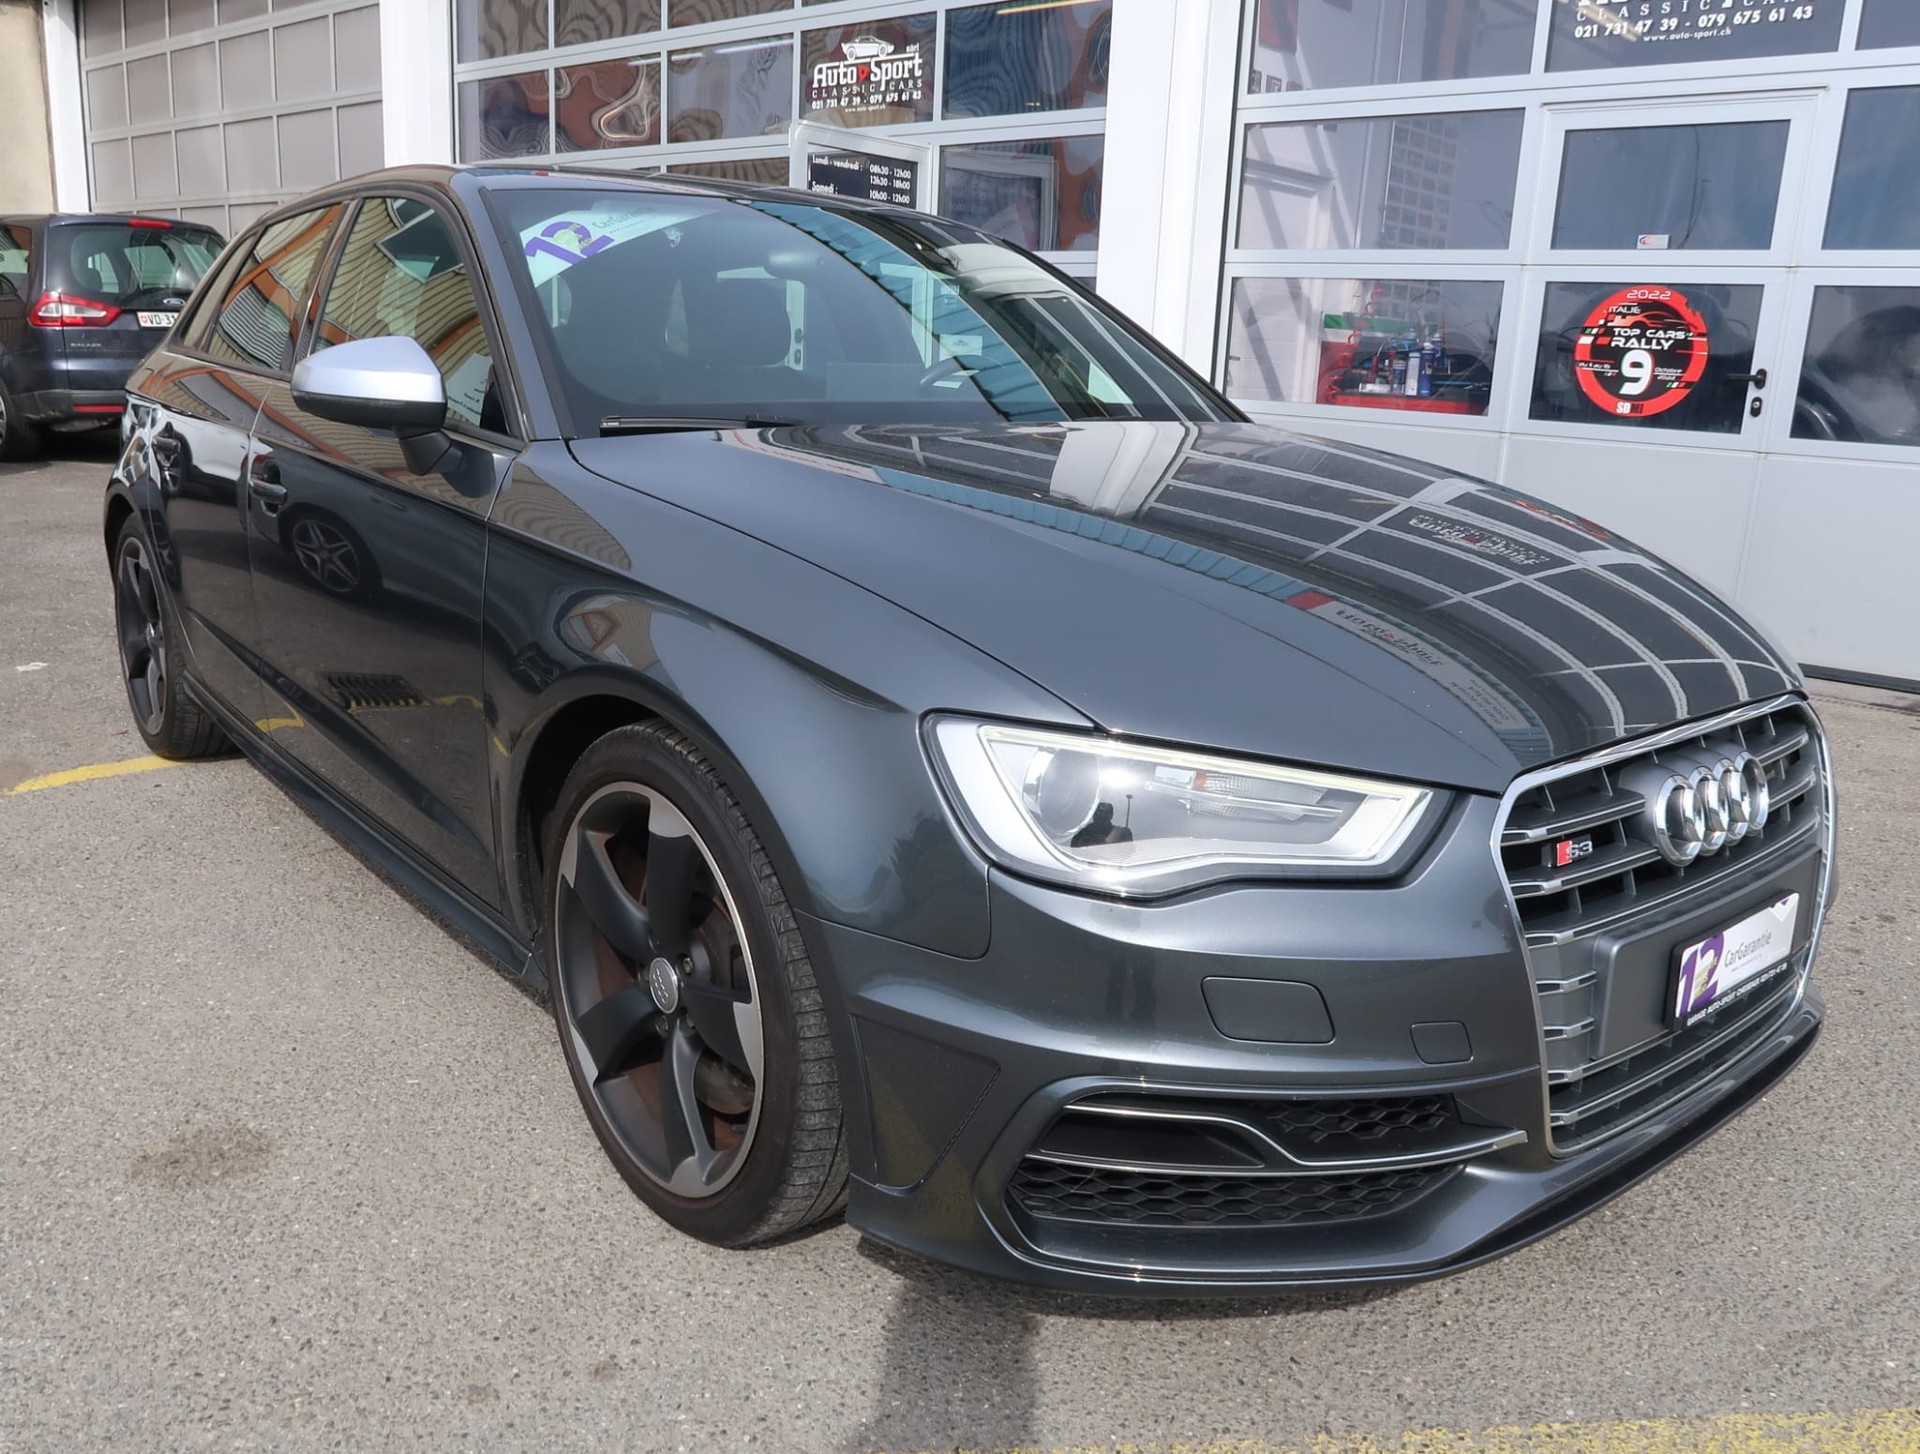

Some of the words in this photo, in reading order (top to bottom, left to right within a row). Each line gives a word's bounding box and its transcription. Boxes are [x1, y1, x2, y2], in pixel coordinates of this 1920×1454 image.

[1577, 0, 1711, 21] CLASSIC
[1575, 25, 1598, 38] 021
[1604, 22, 1627, 36] 731
[1635, 20, 1653, 33] 47
[1659, 18, 1678, 31] 39
[1698, 14, 1726, 28] 079
[1732, 10, 1762, 25] 675
[1768, 7, 1785, 22] 61
[1792, 5, 1813, 20] 43
[1643, 28, 1732, 42] www.auto-sport.ch
[812, 61, 857, 89] Auto
[869, 52, 923, 91] Sport
[811, 84, 876, 98] CLASSIC
[889, 79, 923, 91] CARS
[811, 98, 824, 110] 021
[826, 97, 838, 108] 731
[852, 95, 861, 106] 39
[869, 94, 882, 105] 079
[885, 92, 899, 102] 675
[901, 91, 910, 102] 61
[912, 90, 922, 100] 43
[812, 154, 829, 166] Lundi
[833, 159, 860, 171] vendredi
[869, 164, 889, 175] 08h30
[893, 169, 911, 180] 12h00
[811, 181, 834, 194] Samedi
[869, 189, 888, 201] 10h00
[892, 192, 911, 204] 12h00
[870, 176, 888, 187] 13h30
[892, 179, 911, 190] 18h00
[1626, 289, 1672, 300] 2022
[1608, 306, 1641, 314] ITALIE
[1610, 337, 1675, 350] RALLY
[1613, 328, 1640, 337] TOP
[1646, 329, 1686, 340] CARS
[1618, 349, 1654, 396] 9
[1566, 840, 1593, 859] S3
[1724, 929, 1772, 968] CarGarantie
[1679, 931, 1725, 1018] 12
